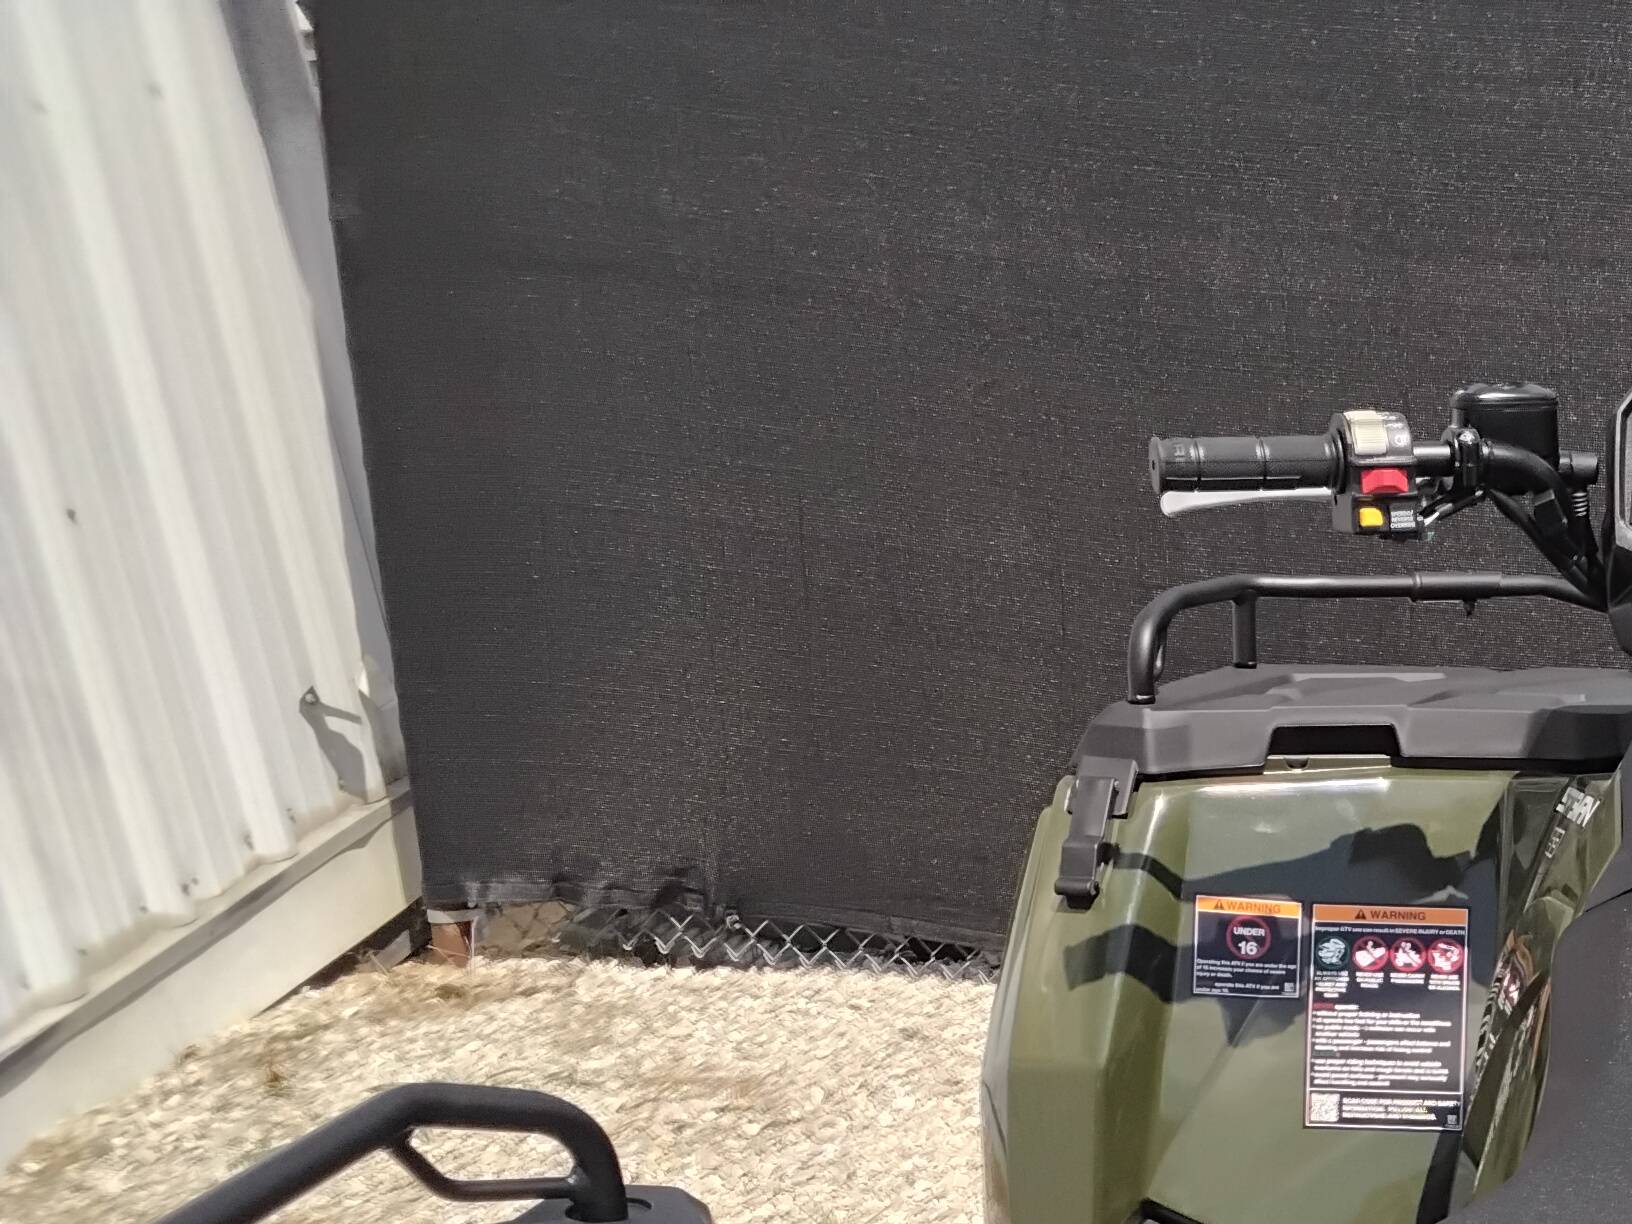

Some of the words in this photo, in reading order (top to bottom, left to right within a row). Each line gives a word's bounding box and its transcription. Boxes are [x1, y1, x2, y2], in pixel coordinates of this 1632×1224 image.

[1227, 901, 1281, 914] WARNING
[1371, 910, 1426, 921] WARNING
[1234, 926, 1265, 937] UNDER
[1237, 940, 1257, 955] 16
